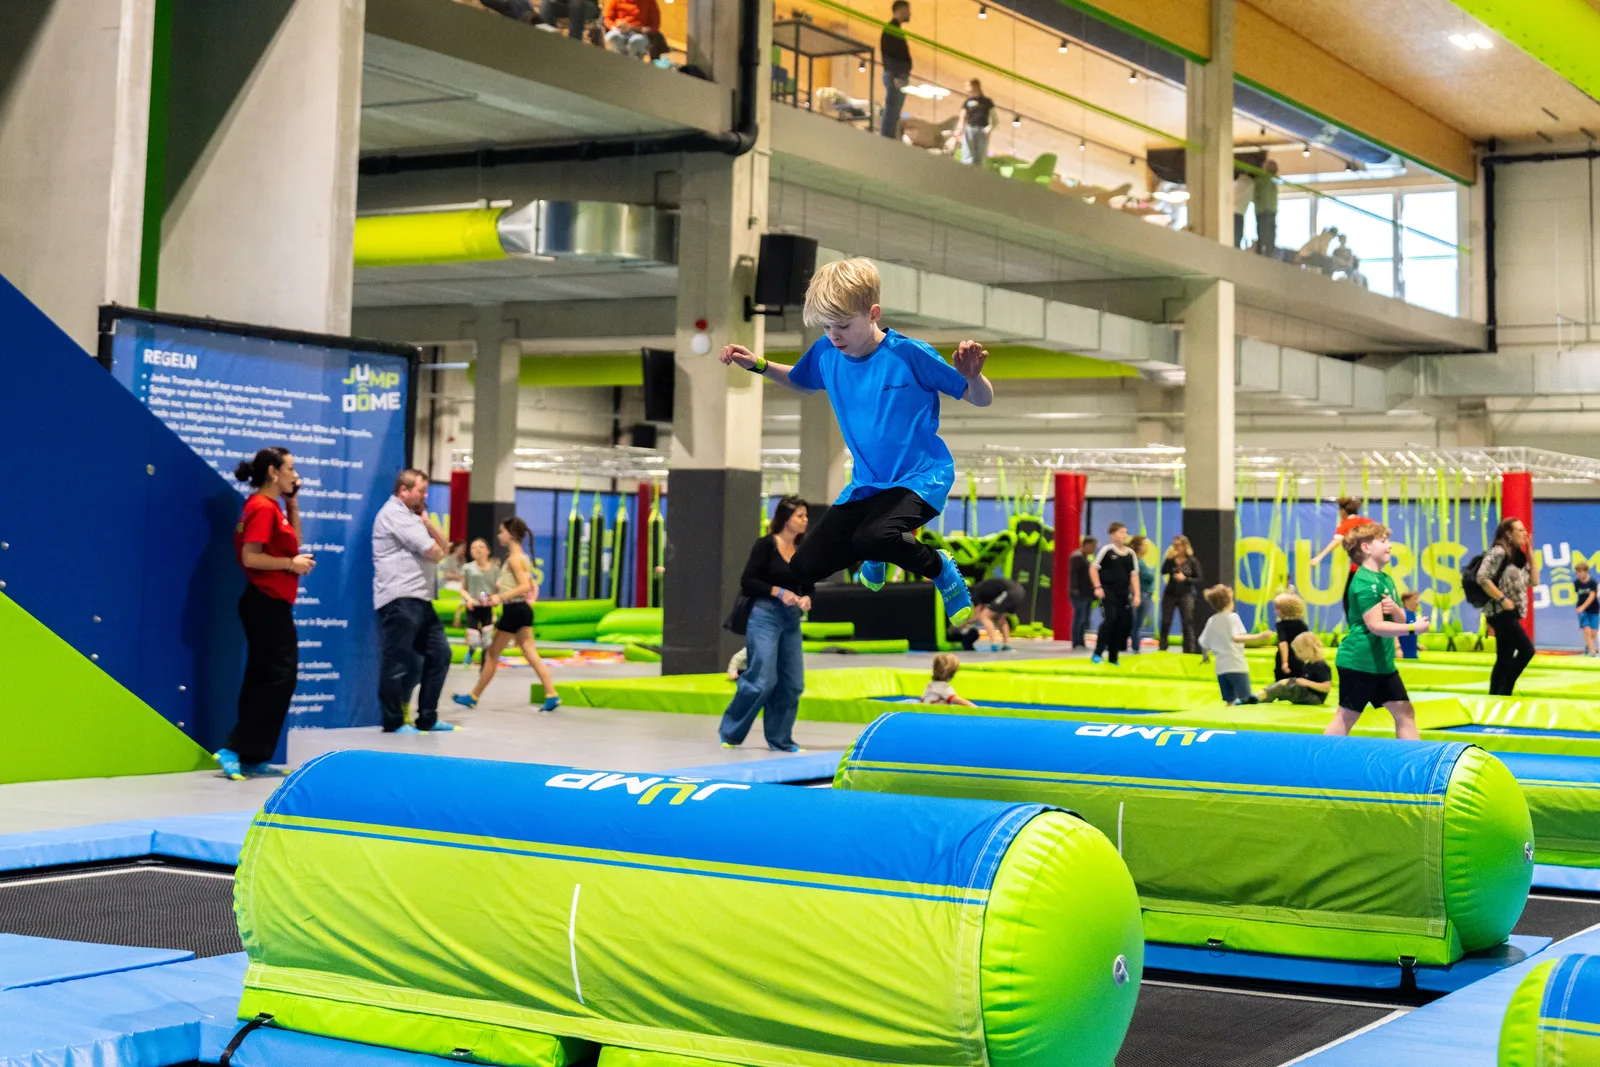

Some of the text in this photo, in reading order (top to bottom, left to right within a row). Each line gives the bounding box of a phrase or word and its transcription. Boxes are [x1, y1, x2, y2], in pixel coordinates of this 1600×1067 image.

[143, 348, 197, 370] REGELN
[342, 363, 400, 388] JUMP
[342, 392, 401, 413] DOME
[1075, 724, 1237, 746] JUMP
[545, 772, 752, 805] JUMP
